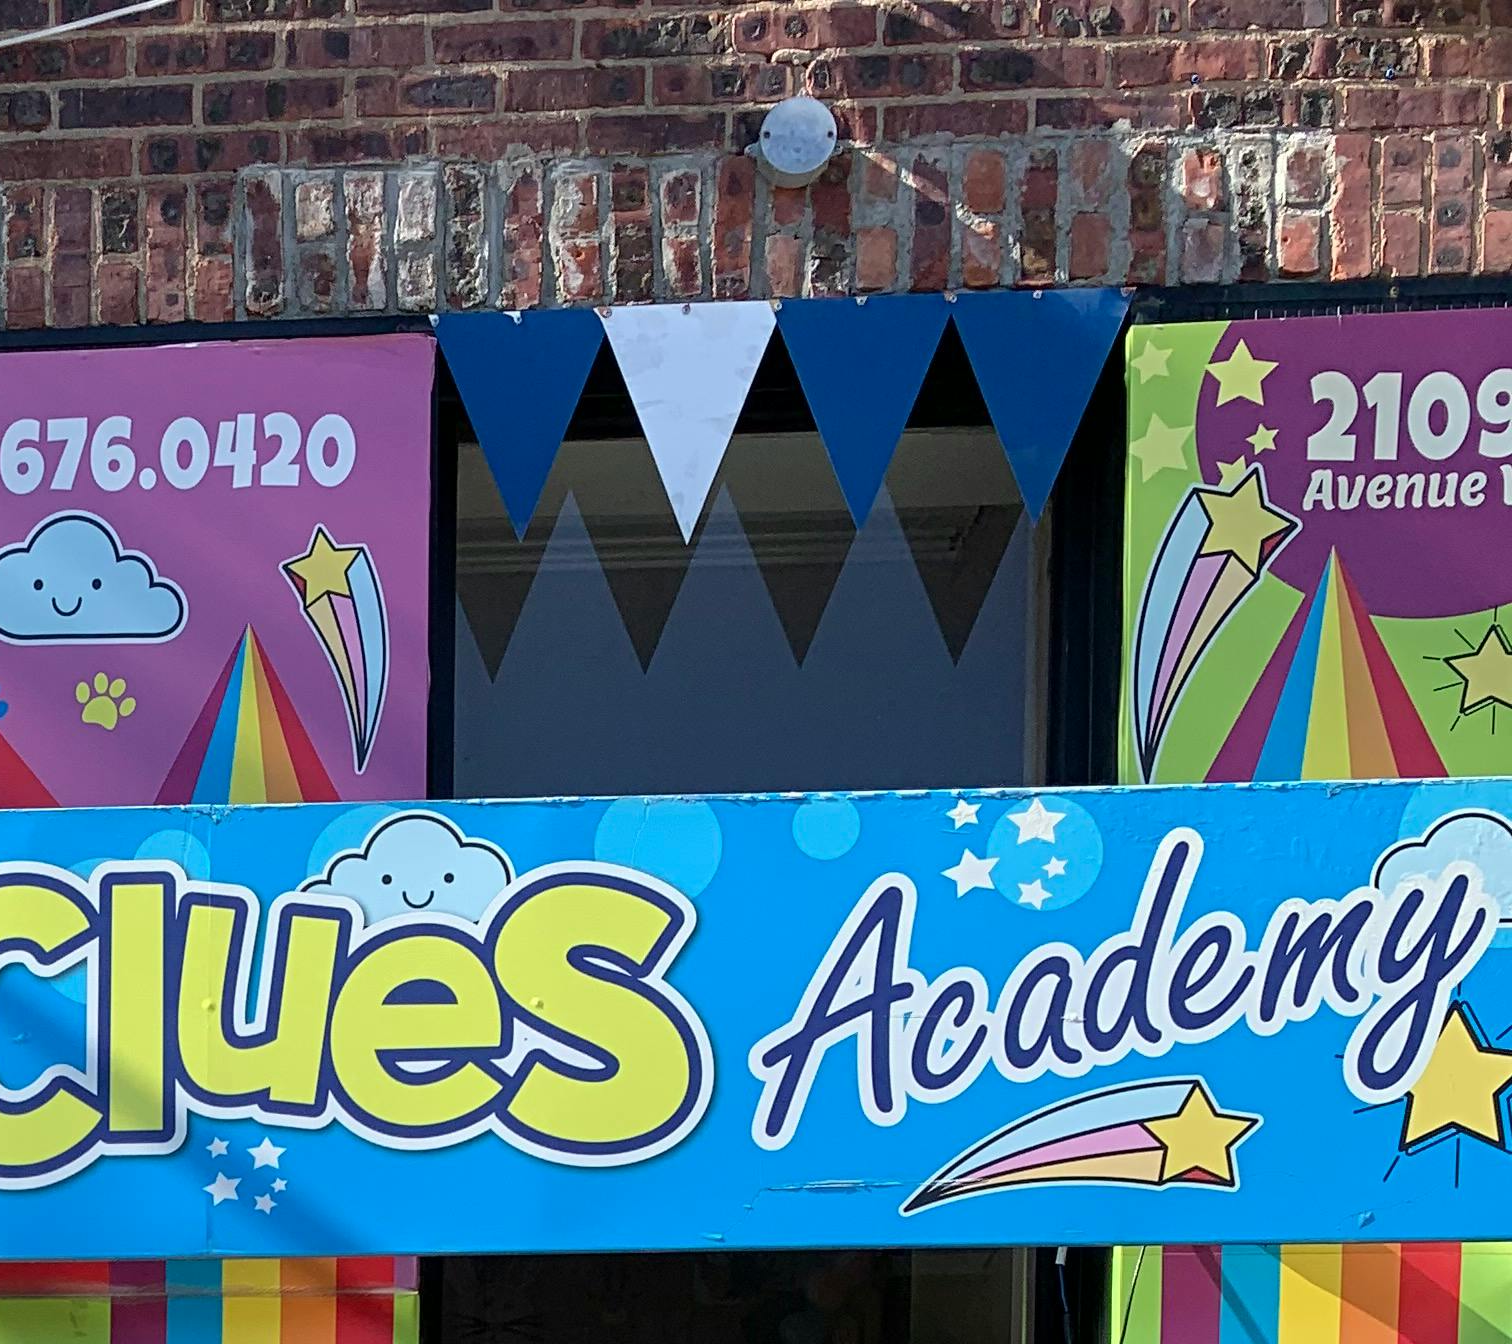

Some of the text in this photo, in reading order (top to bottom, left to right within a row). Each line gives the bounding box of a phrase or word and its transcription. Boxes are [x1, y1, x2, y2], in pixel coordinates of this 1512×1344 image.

[1307, 368, 1512, 462] 2109
[1302, 468, 1487, 512] Avenue
[760, 838, 1488, 1140] Academy
